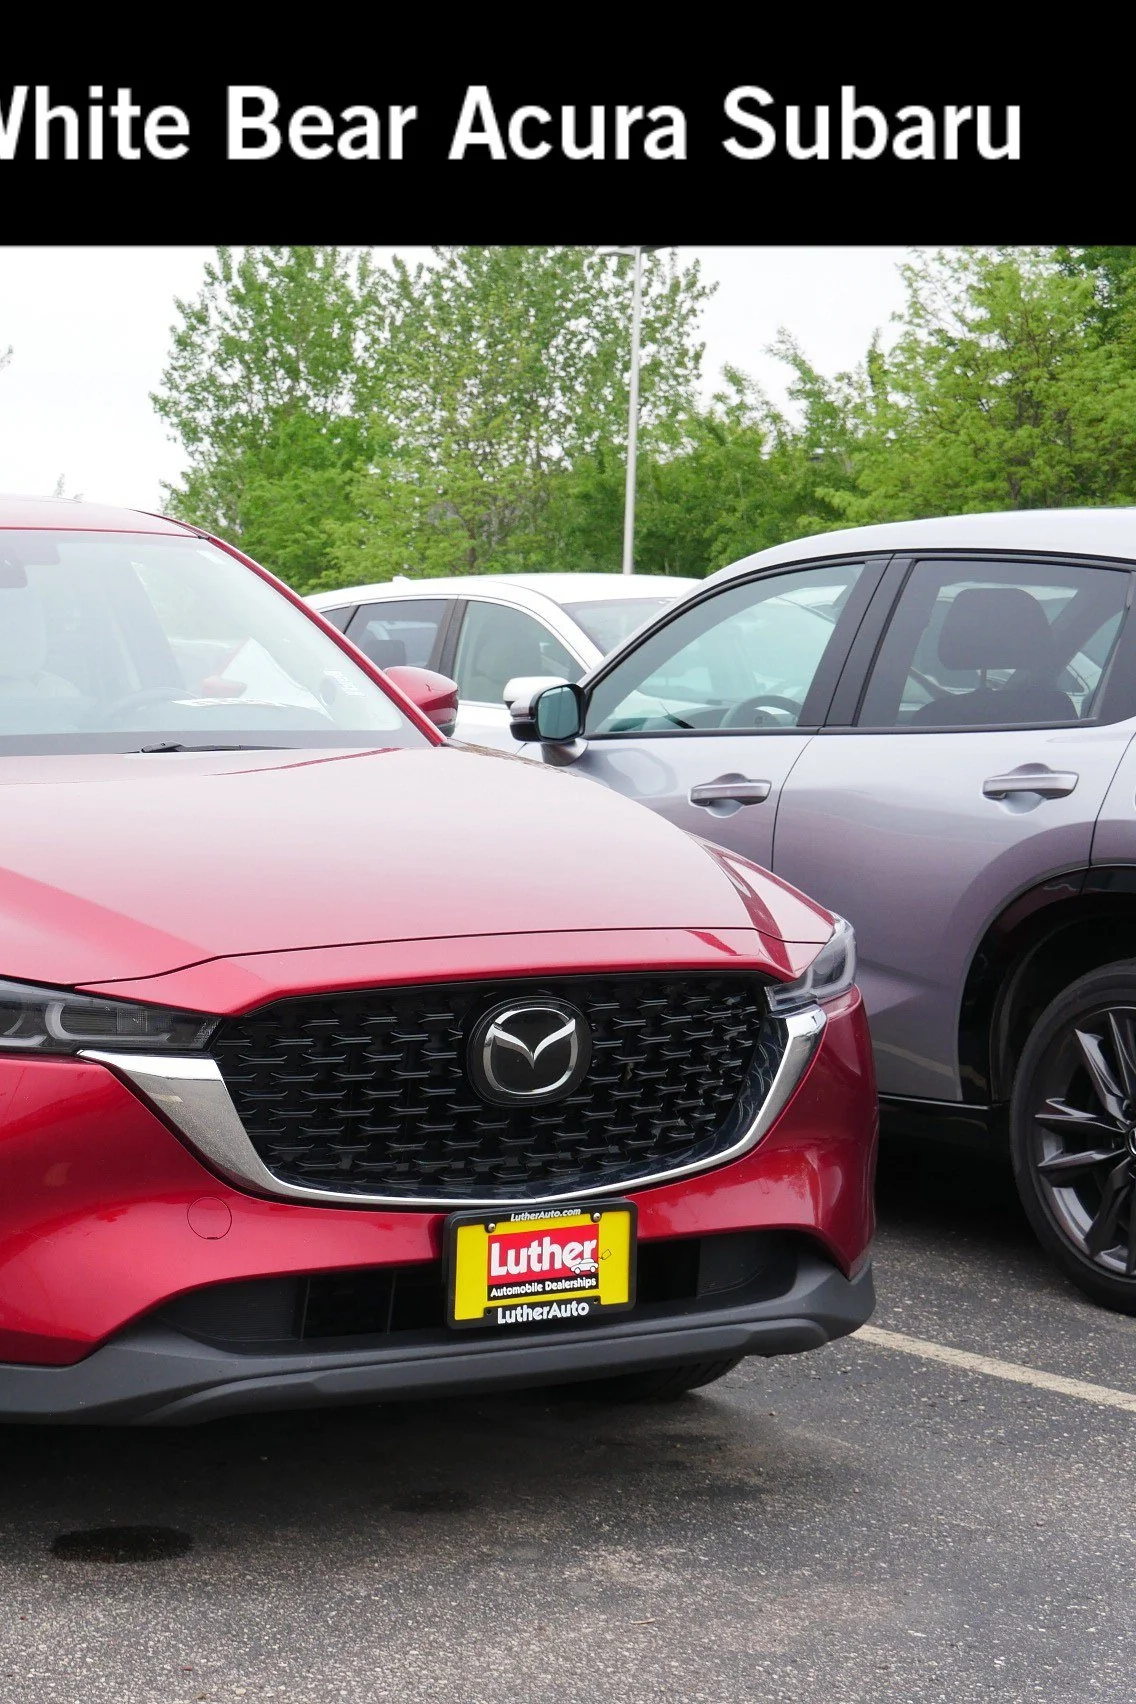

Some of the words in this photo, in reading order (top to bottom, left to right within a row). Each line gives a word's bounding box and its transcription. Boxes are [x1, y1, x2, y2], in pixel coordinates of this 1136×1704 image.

[510, 1208, 581, 1222] LutherAuto.com
[490, 1236, 597, 1277] Luther
[490, 1282, 543, 1298] Automobile
[545, 1276, 597, 1291] Dealerships
[497, 1300, 590, 1325] LutherAuto
